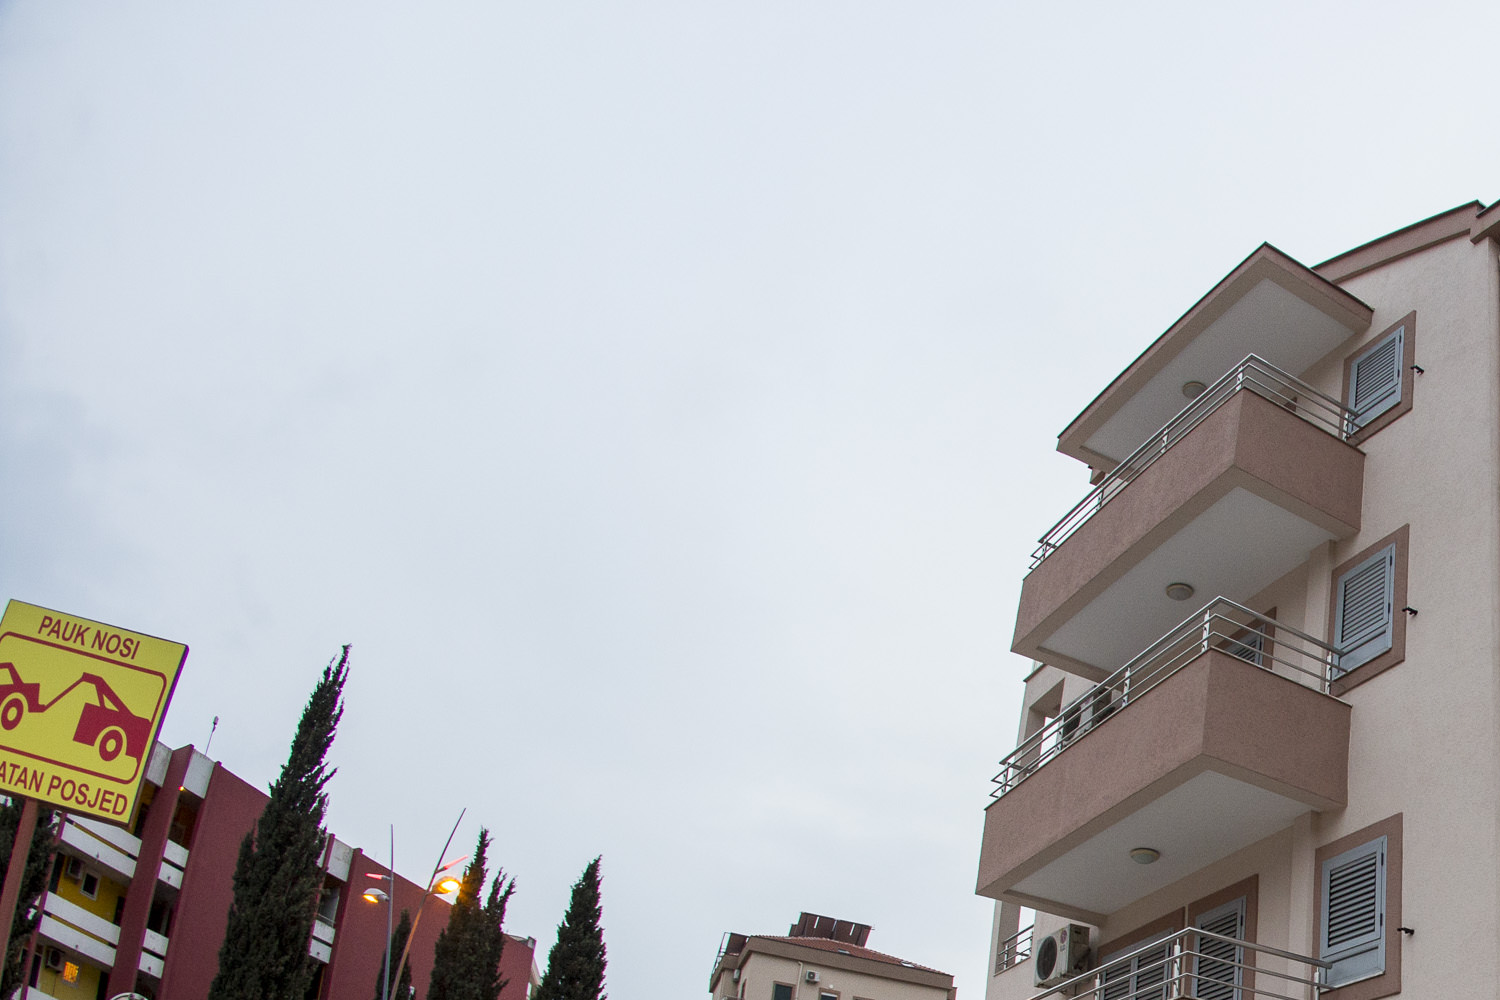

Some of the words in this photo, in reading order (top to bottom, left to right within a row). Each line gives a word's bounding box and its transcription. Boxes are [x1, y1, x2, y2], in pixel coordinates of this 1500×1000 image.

[38, 615, 91, 646] PAUK
[91, 630, 140, 660] NOSI
[46, 774, 128, 816] POSJED
